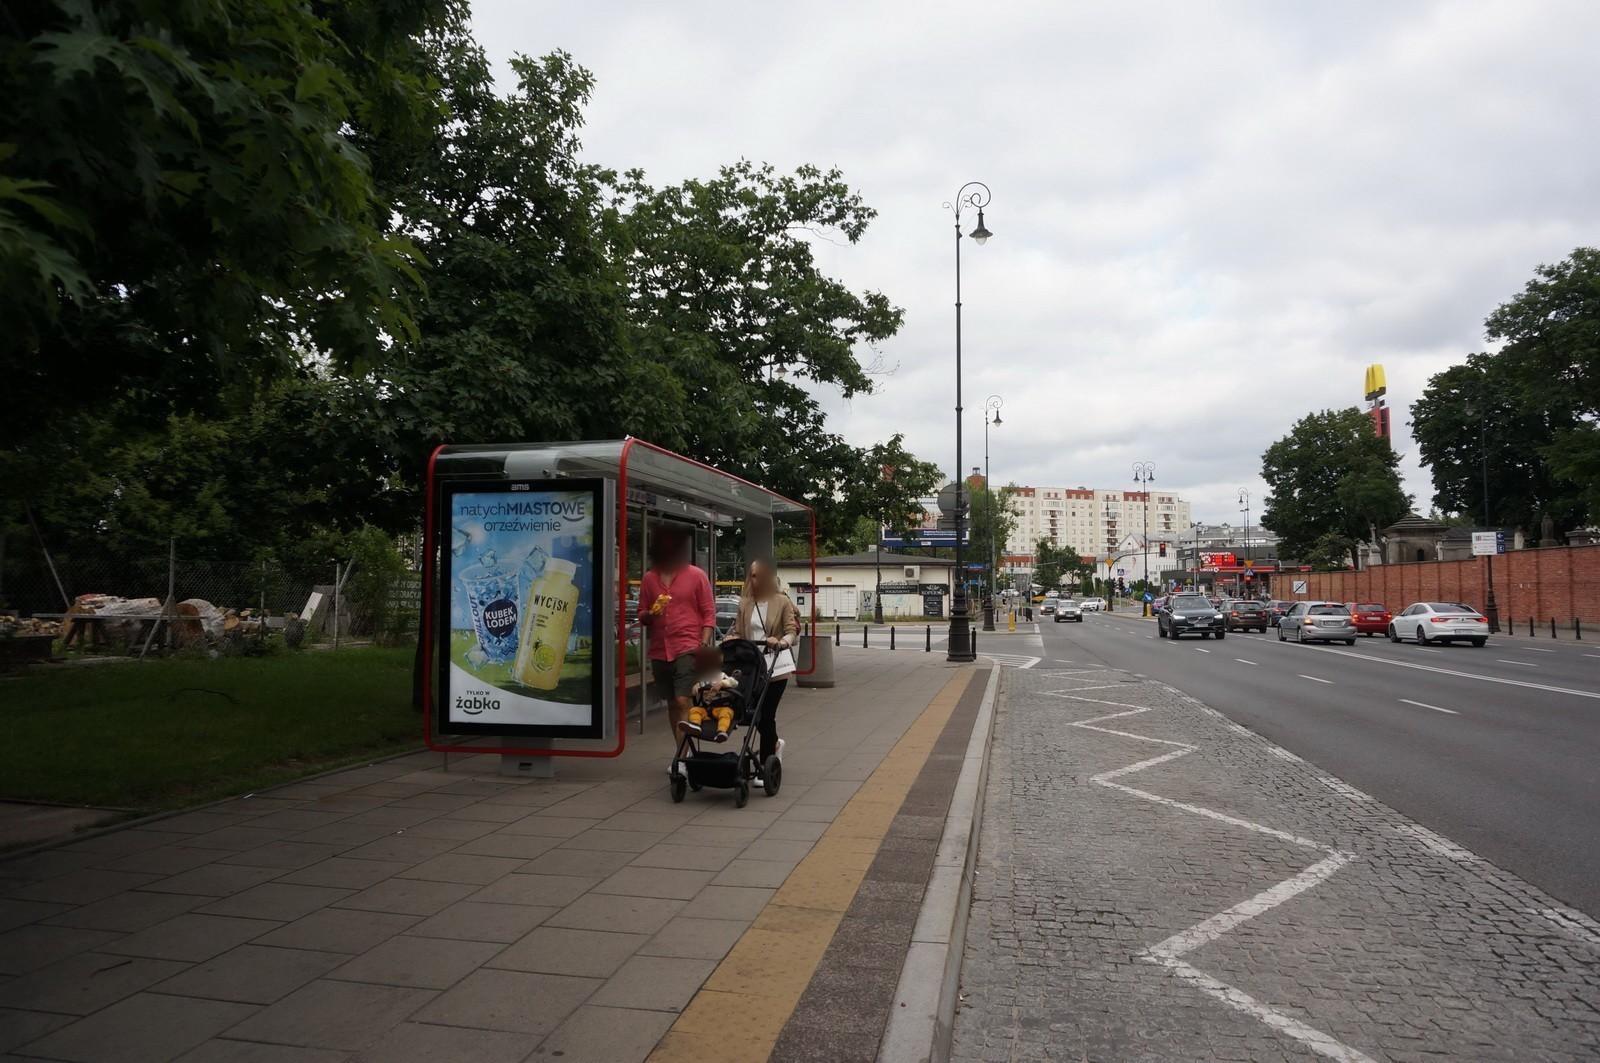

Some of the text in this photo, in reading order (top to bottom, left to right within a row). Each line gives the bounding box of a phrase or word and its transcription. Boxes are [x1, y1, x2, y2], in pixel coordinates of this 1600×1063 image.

[511, 483, 530, 491] ams
[460, 502, 585, 519] natychMIASTOWE
[484, 517, 561, 532] orzeźwienie
[485, 606, 514, 620] KUBEK
[486, 614, 517, 628] LODEM
[456, 696, 501, 710] żabka
